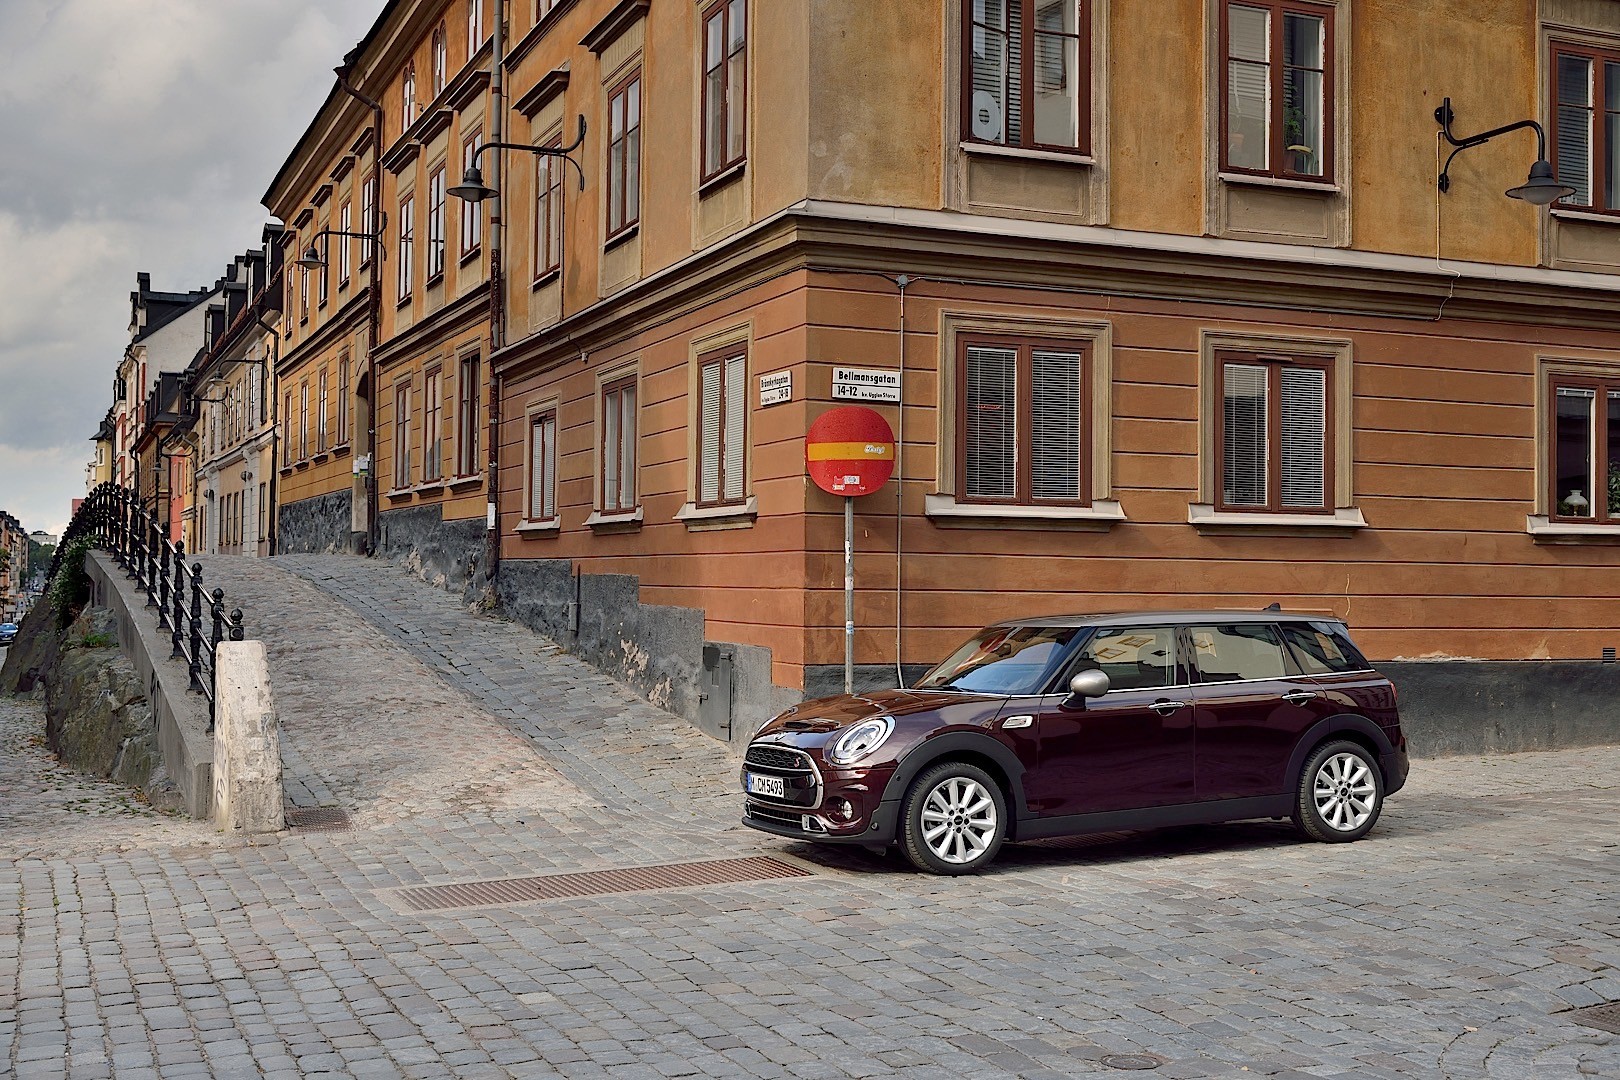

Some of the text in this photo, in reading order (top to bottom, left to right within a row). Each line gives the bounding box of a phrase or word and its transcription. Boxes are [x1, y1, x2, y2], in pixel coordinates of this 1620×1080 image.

[838, 371, 896, 384] Bellmansgatan
[837, 385, 858, 396] 14-12
[766, 779, 783, 795] 5493
